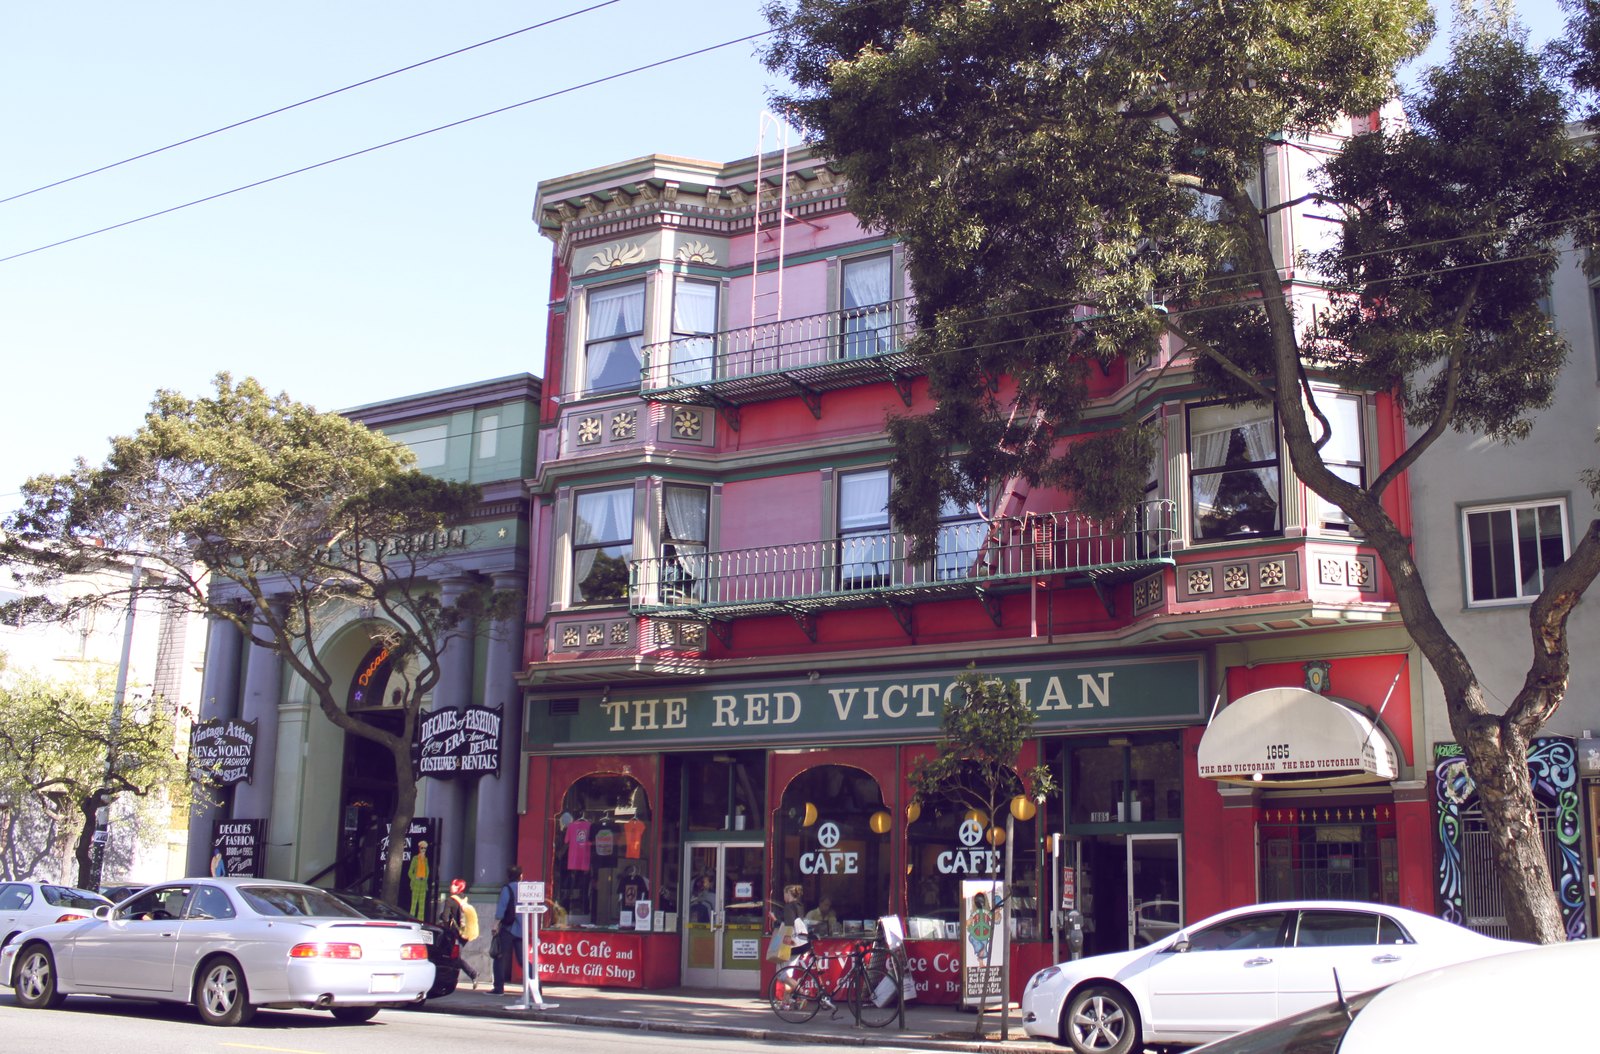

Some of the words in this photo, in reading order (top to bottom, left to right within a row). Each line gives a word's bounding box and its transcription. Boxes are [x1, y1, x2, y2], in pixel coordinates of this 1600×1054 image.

[359, 648, 389, 686] Decad
[606, 697, 688, 732] THE
[711, 692, 802, 728] RED
[828, 672, 1114, 721] VICTIAN
[191, 725, 224, 745] Vintage
[225, 721, 253, 745] Attire
[421, 710, 457, 743] DECADES
[465, 709, 500, 740] FASHION
[207, 747, 218, 757] &
[217, 745, 251, 757] WOMEN
[444, 729, 465, 755] ERA
[469, 739, 498, 754] DETAIL
[224, 757, 251, 766] FASHION
[1266, 744, 1289, 760] 1665
[420, 755, 457, 772] COSTUMES
[461, 754, 498, 770] RENTALS
[1200, 766, 1215, 774] THE
[1217, 764, 1232, 773] RED
[1234, 762, 1276, 772] VICTORIAN
[1282, 761, 1298, 770] THE
[1299, 760, 1315, 769] RED
[1317, 758, 1360, 768] VICTORIAN
[222, 767, 248, 781] SELL
[220, 824, 251, 834] DECADES
[226, 836, 254, 846] FASHION
[799, 852, 858, 875] CAFE
[937, 851, 1001, 875] CAFE
[577, 940, 611, 958] Cafe
[616, 950, 633, 960] and
[538, 963, 554, 973] ace
[557, 962, 580, 975] Arts
[583, 963, 602, 977] Gift
[606, 964, 635, 981] Shop
